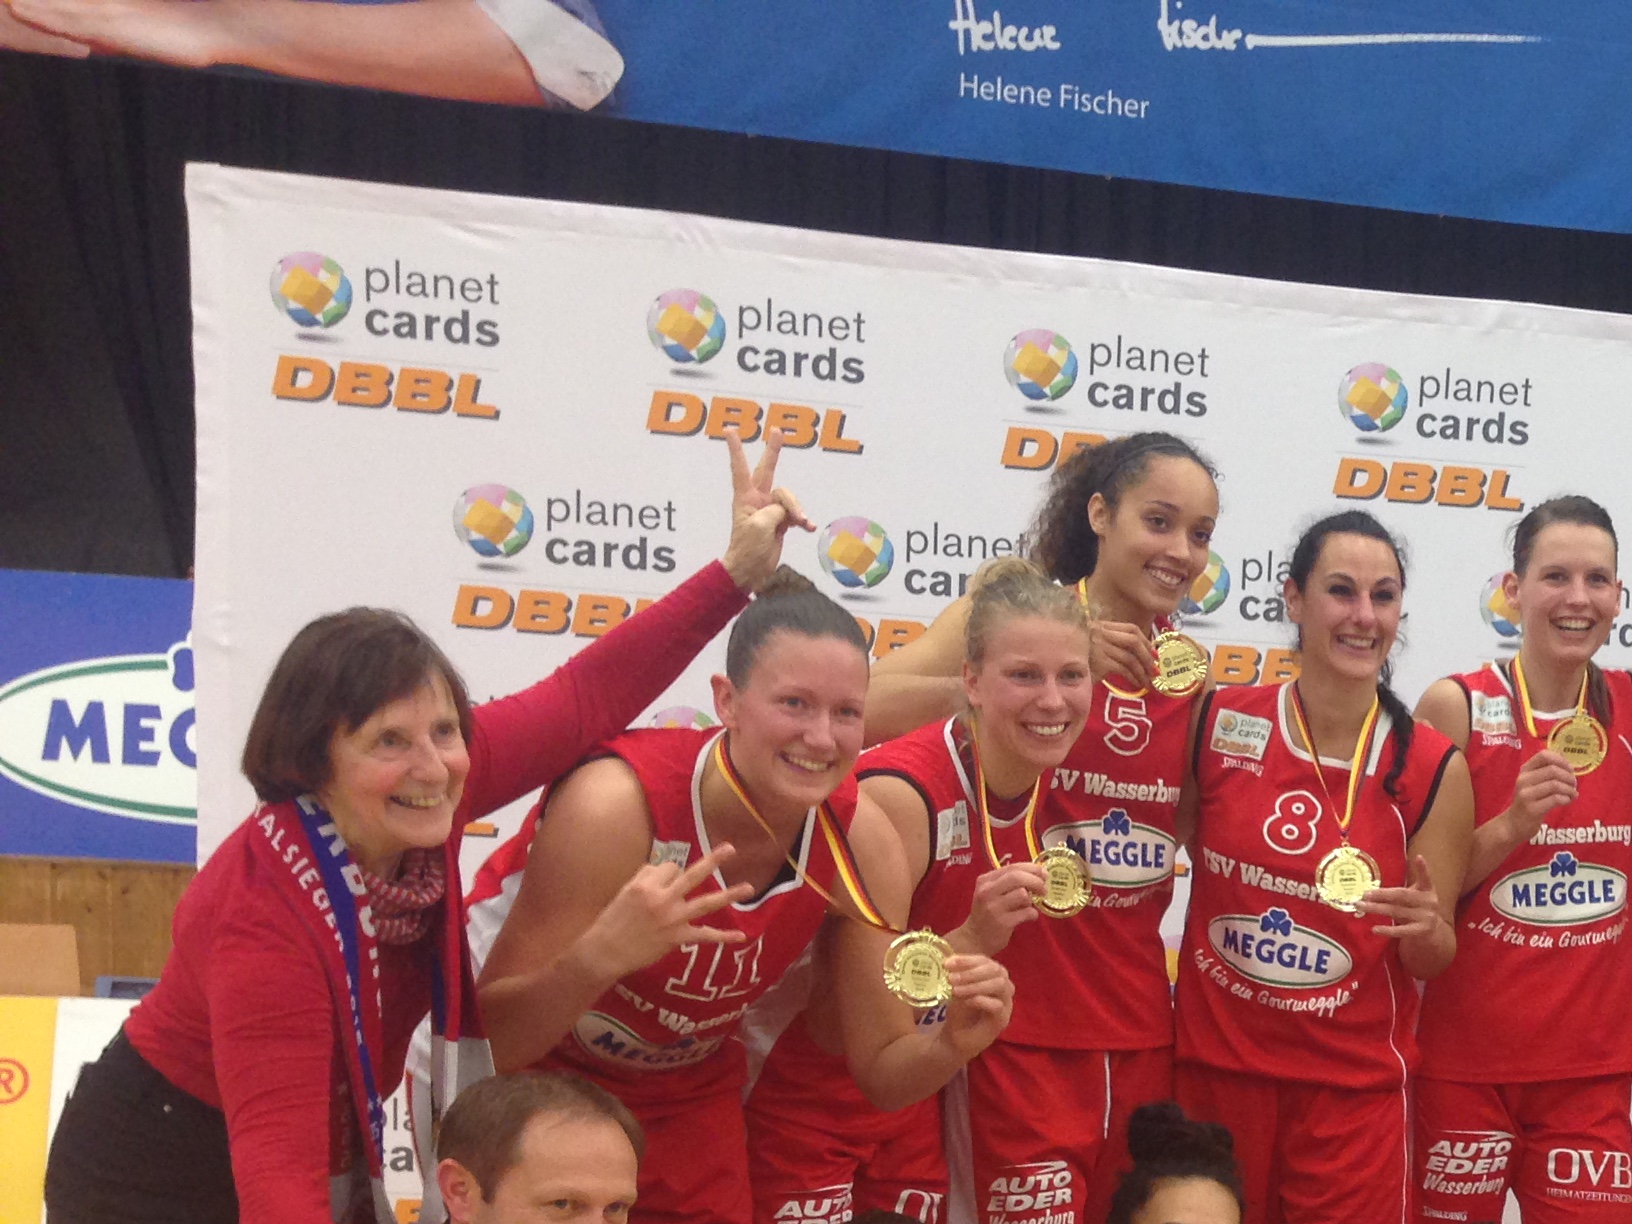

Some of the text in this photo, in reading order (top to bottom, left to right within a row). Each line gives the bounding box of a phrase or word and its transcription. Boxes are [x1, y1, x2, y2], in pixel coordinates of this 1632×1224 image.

[959, 72, 1150, 119] Helene Fischer
[365, 259, 500, 304] planet
[364, 307, 501, 348] cards
[737, 297, 867, 344] planet
[736, 344, 866, 385] cards
[1088, 334, 1210, 378] planet
[271, 354, 501, 422] DBBL
[1087, 380, 1208, 418] cards
[1419, 367, 1533, 408] planet
[645, 389, 865, 456] DBBL
[1416, 411, 1530, 446] cards
[1332, 456, 1526, 513] DBBL
[546, 489, 677, 532] planet
[545, 536, 677, 574] cards
[1103, 690, 1153, 757] 5
[1238, 729, 1268, 742] cards
[1221, 756, 1264, 778] SPALDING
[1262, 790, 1323, 855] 8
[1529, 819, 1632, 846] Wasserburg
[1203, 847, 1236, 879] TSV
[1511, 879, 1616, 909] MEGGLE
[1223, 926, 1331, 976] MEGGLE
[1503, 926, 1525, 946] bin
[1530, 930, 1554, 949] ein
[1230, 980, 1254, 1001] ein
[1426, 1155, 1508, 1176] EDER
[1428, 1139, 1513, 1158] AUTO
[1547, 1147, 1632, 1189] OVB
[987, 1187, 1072, 1213] EDER
[989, 1170, 1073, 1194] AUTO
[1422, 1171, 1505, 1196] Wasserburg
